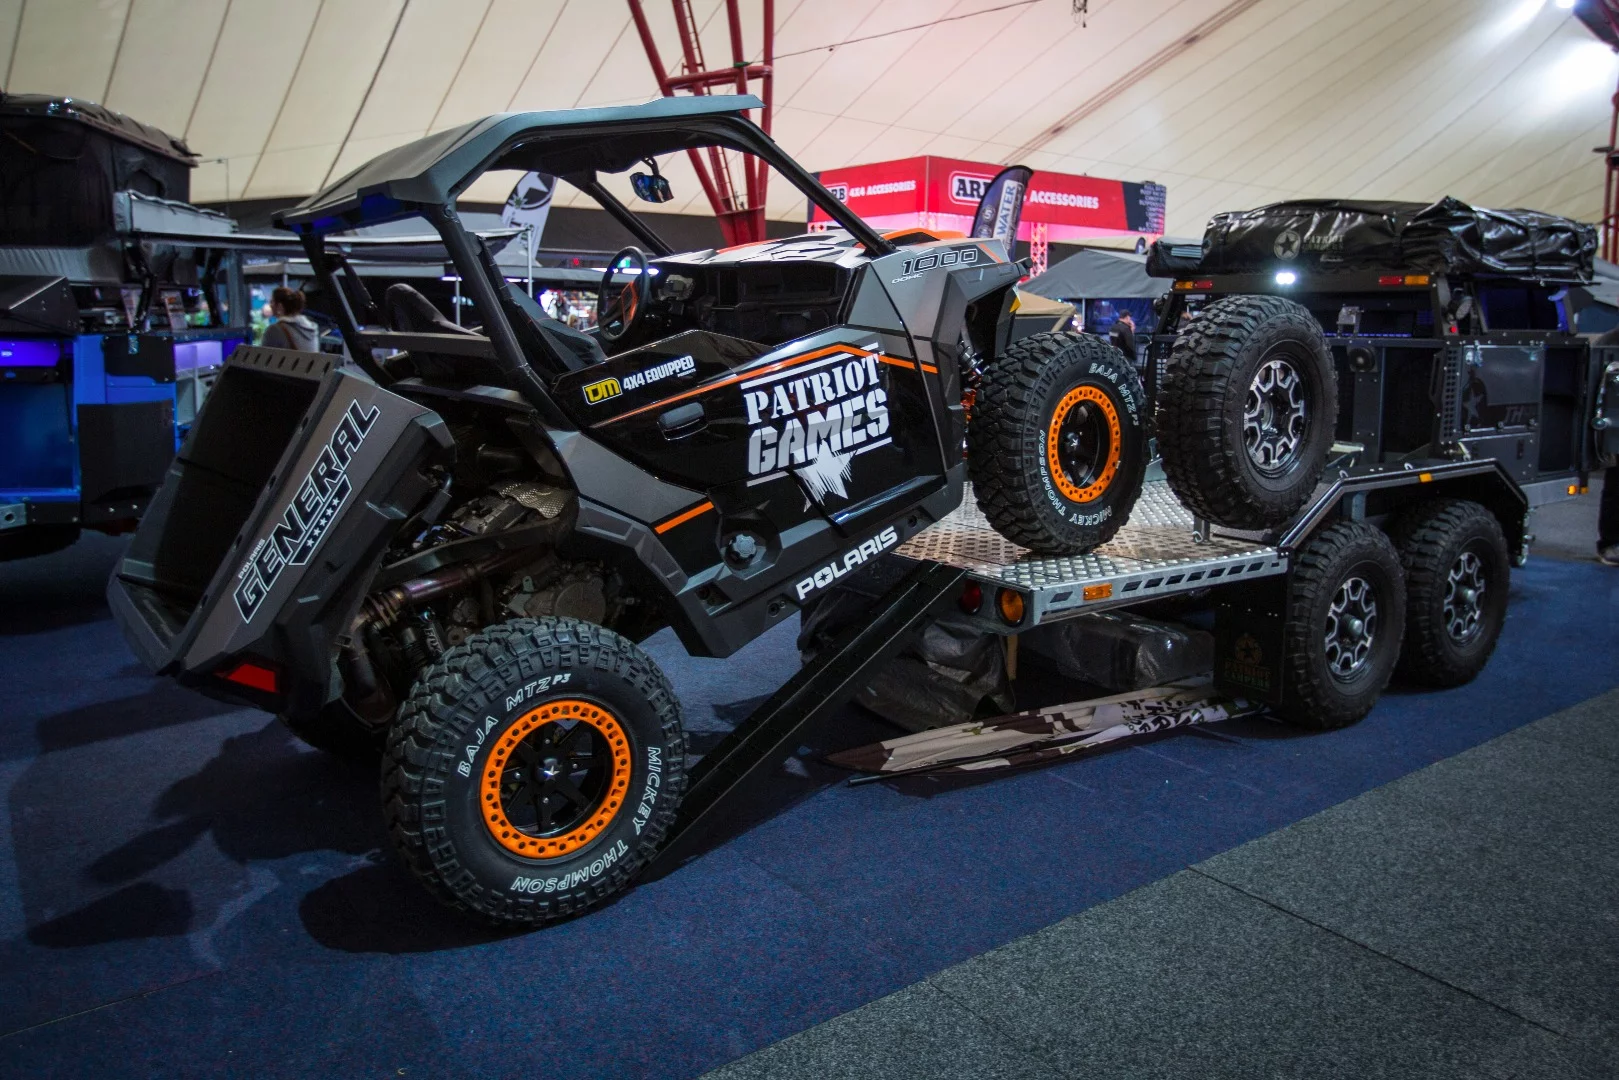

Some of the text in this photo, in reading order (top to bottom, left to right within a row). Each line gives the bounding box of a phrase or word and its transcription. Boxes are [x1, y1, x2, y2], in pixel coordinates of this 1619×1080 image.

[866, 180, 917, 196] ACCESSORIES
[996, 185, 1016, 236] WATER
[1030, 190, 1100, 209] ACCESSORIES
[902, 248, 978, 276] 1000
[585, 355, 695, 404] TJM 4X4 EQUIPPED
[744, 353, 881, 426] PATRIOT
[1089, 362, 1118, 384] BAJA
[748, 387, 890, 475] GAMES
[1038, 429, 1112, 527] MICKEY THOMPSON
[233, 398, 381, 624] GENERAL
[238, 538, 266, 580] POLARIS
[796, 525, 898, 600] POLARIS
[456, 714, 499, 778] BAJA
[505, 679, 551, 712] MTZ
[511, 747, 662, 894] MICKEY THOMPSON
